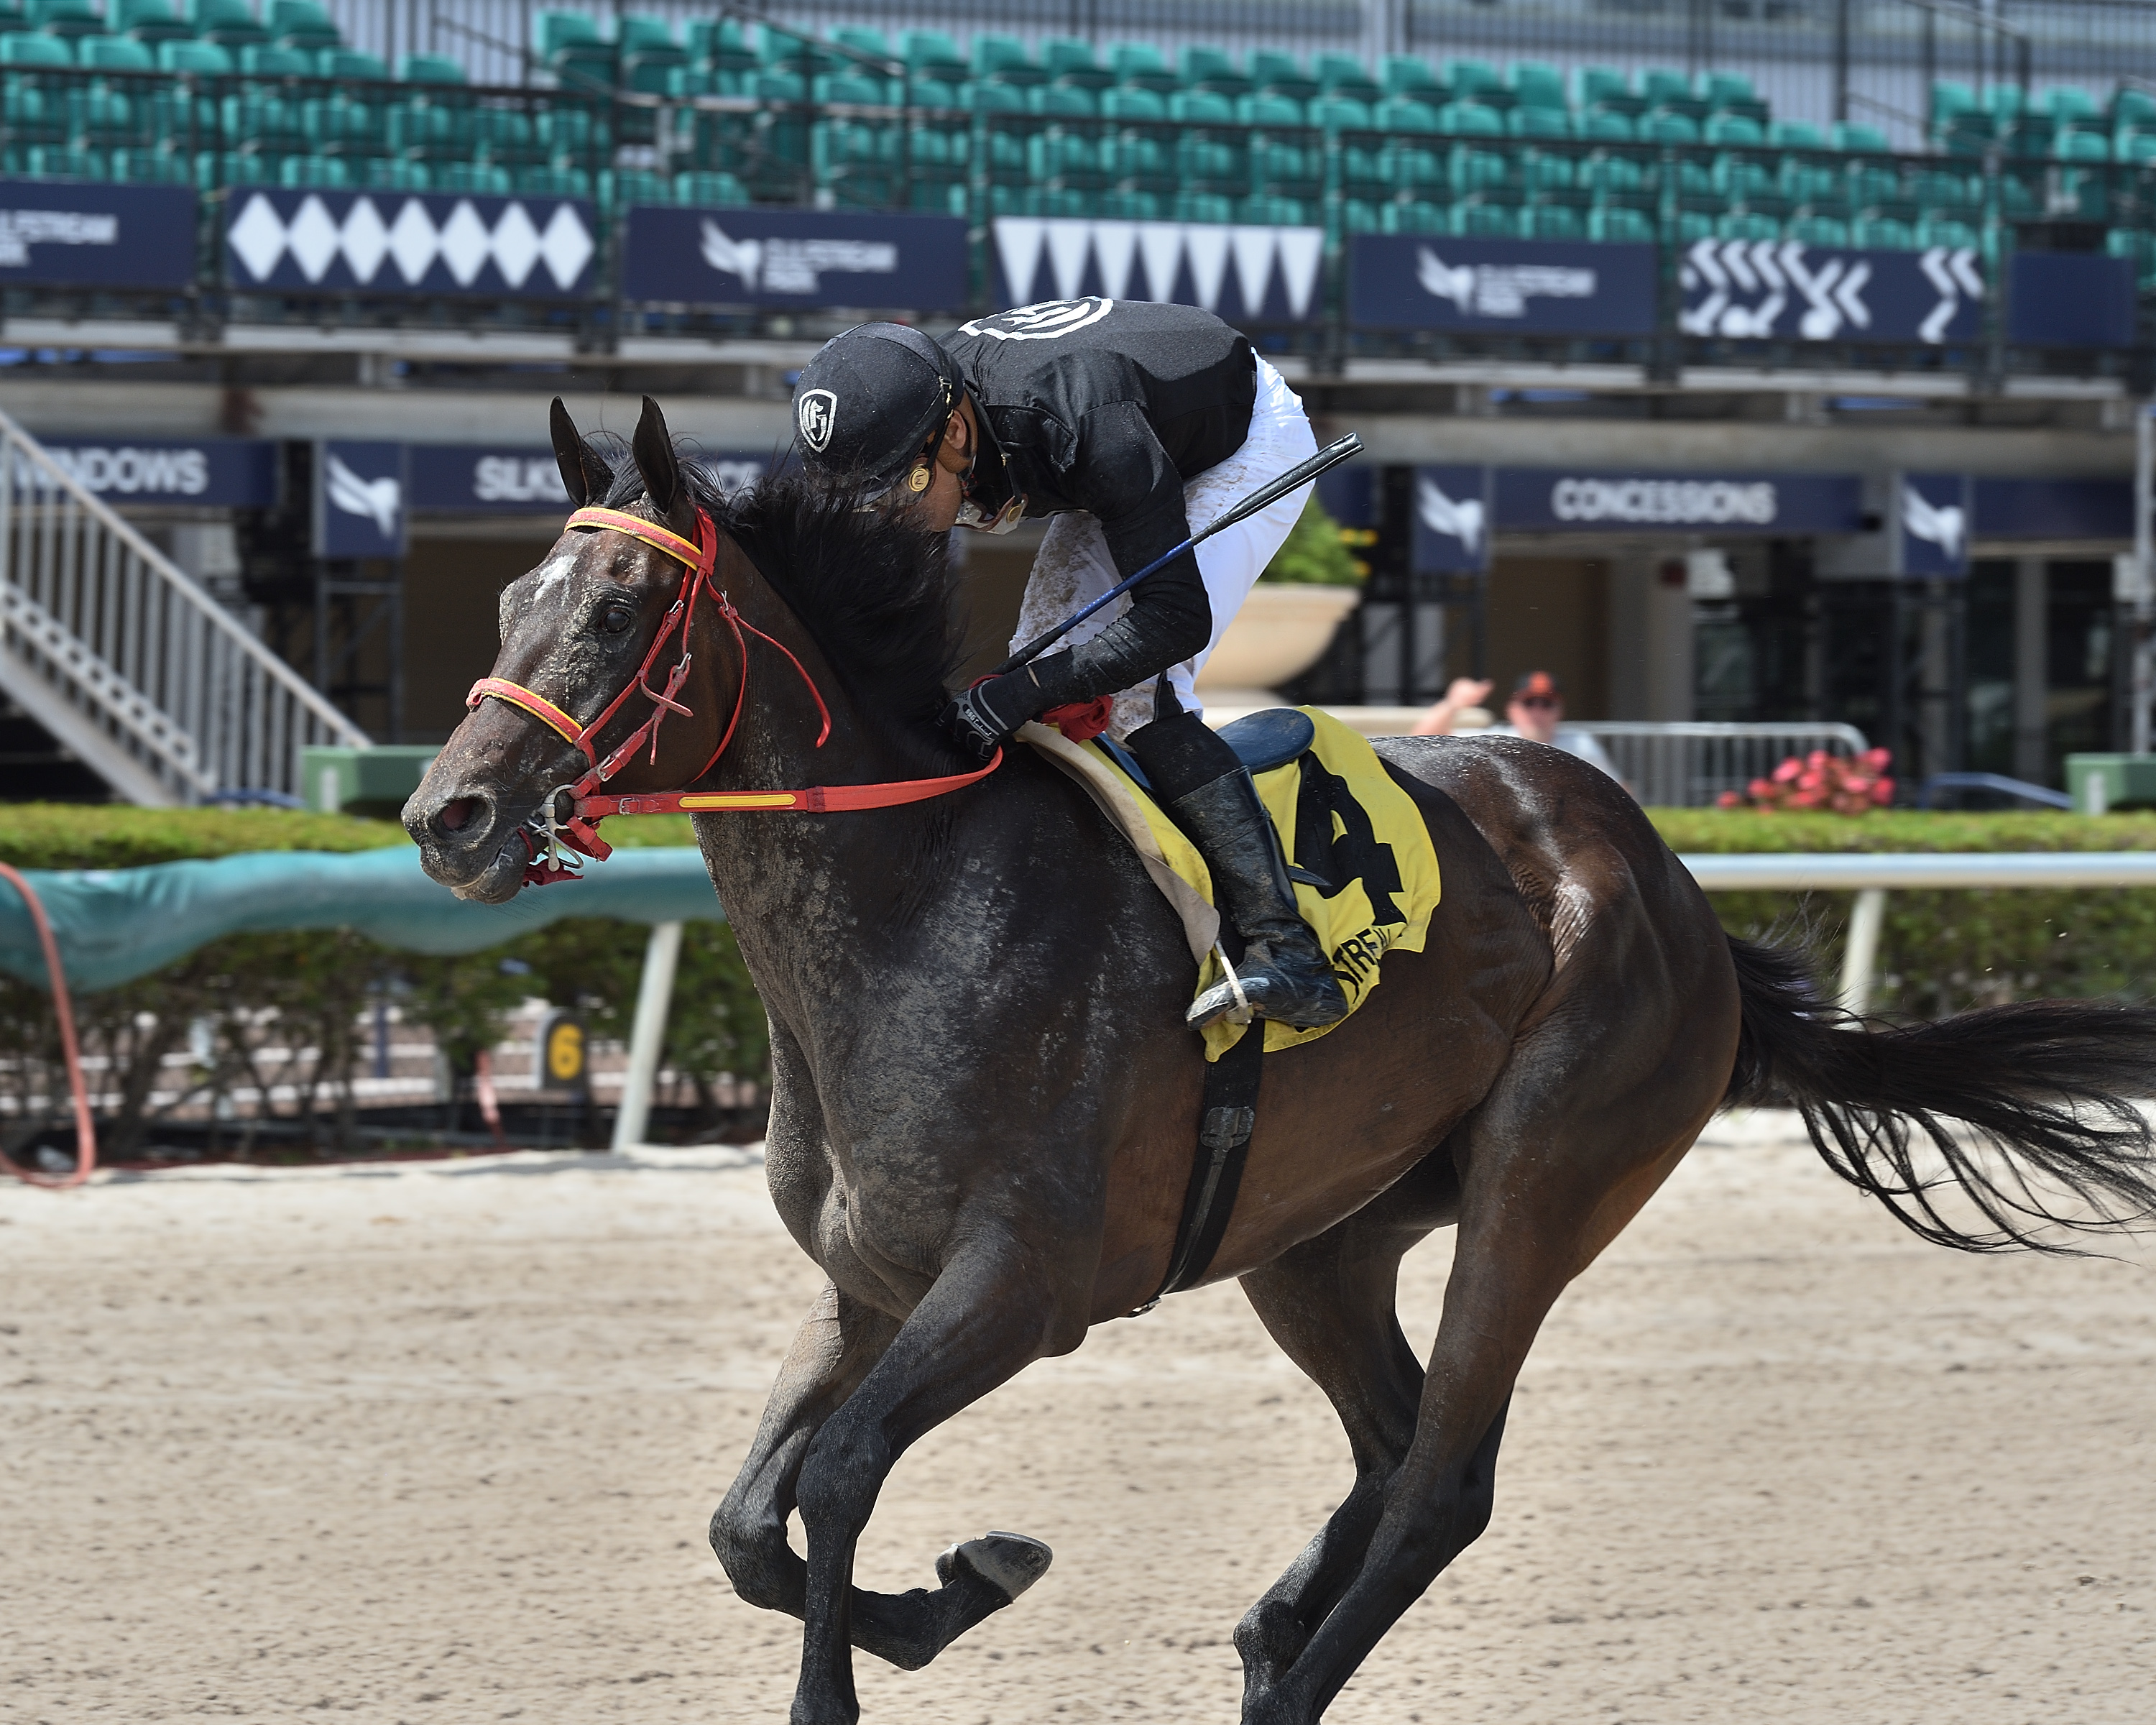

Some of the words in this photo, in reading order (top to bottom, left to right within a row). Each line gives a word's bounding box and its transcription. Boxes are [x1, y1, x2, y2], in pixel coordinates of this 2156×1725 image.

[1552, 478, 1776, 524] CONCESSIONS
[965, 708, 977, 721] SSG
[1294, 750, 1406, 926] 4
[548, 1023, 584, 1080] 6
